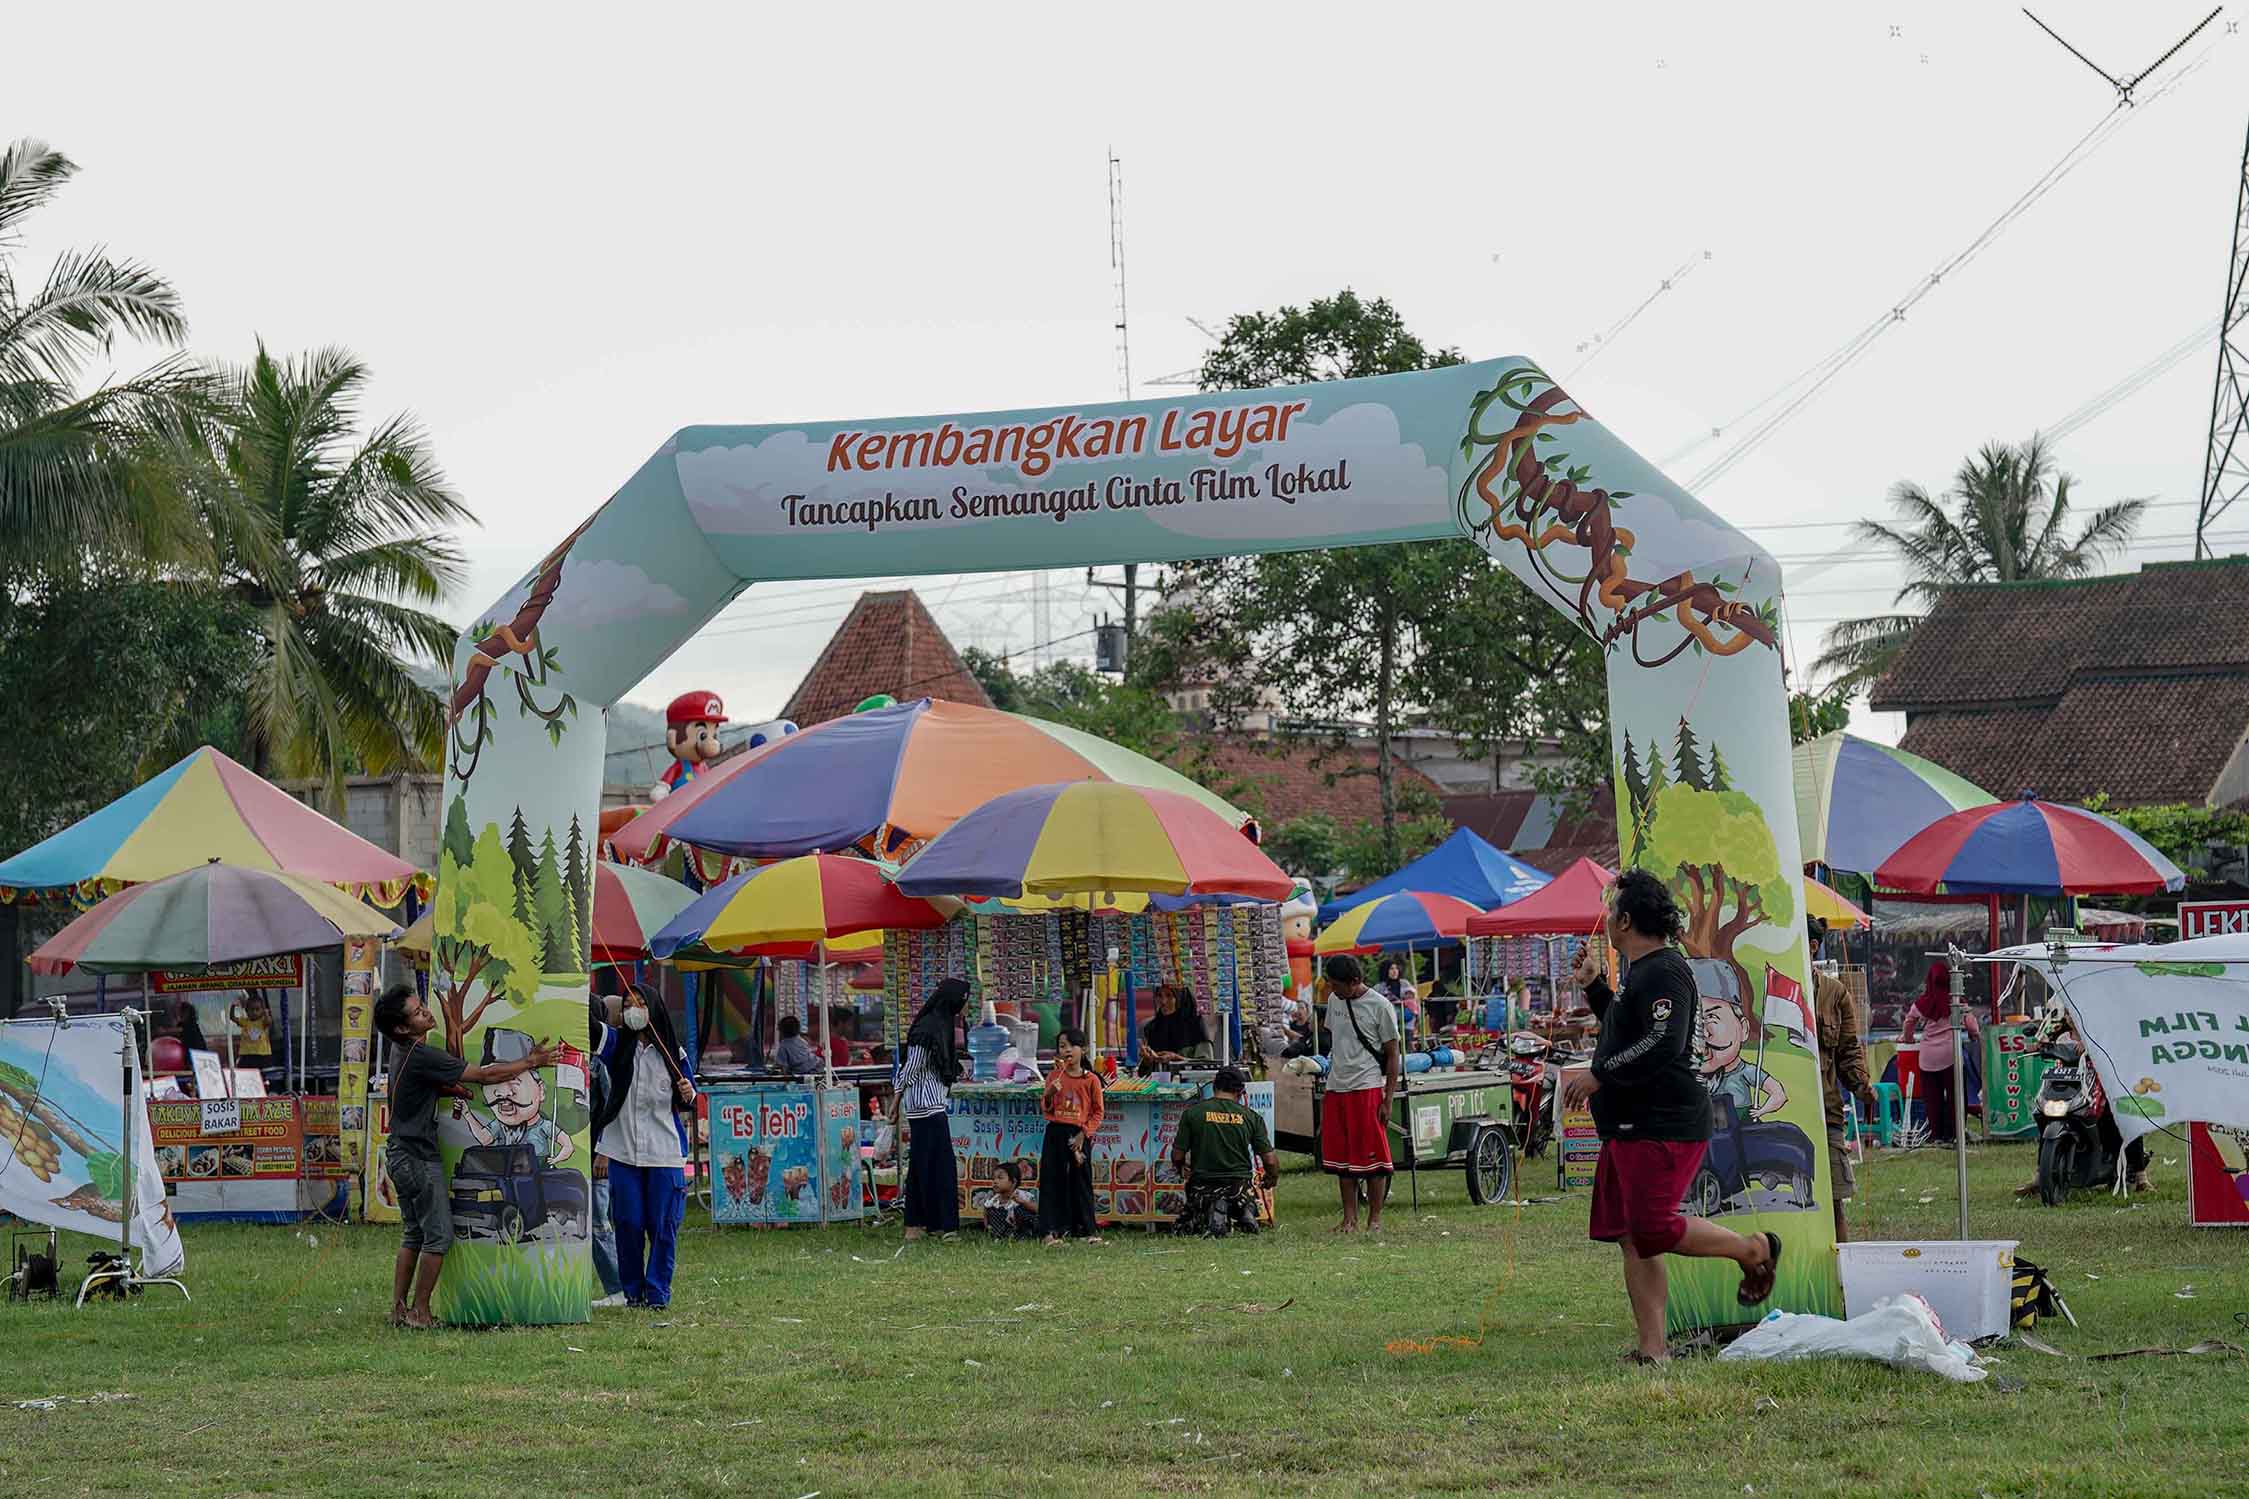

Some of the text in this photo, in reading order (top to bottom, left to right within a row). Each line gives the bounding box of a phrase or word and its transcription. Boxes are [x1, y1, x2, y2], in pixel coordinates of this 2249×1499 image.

[827, 401, 1306, 477] Kembangkan Layar
[780, 458, 1353, 532] Tancapkan Semangat Cinta Film Lokal
[1998, 1035, 2025, 1053] ES
[150, 1102, 201, 1124] TAKOYA
[207, 1101, 236, 1114] SOSIS
[1448, 1095, 1465, 1119] POP
[204, 1117, 238, 1130] BAKAR
[263, 1126, 285, 1136] FOOD
[973, 1119, 1001, 1134] Sosis
[1017, 1119, 1045, 1134] Seafo
